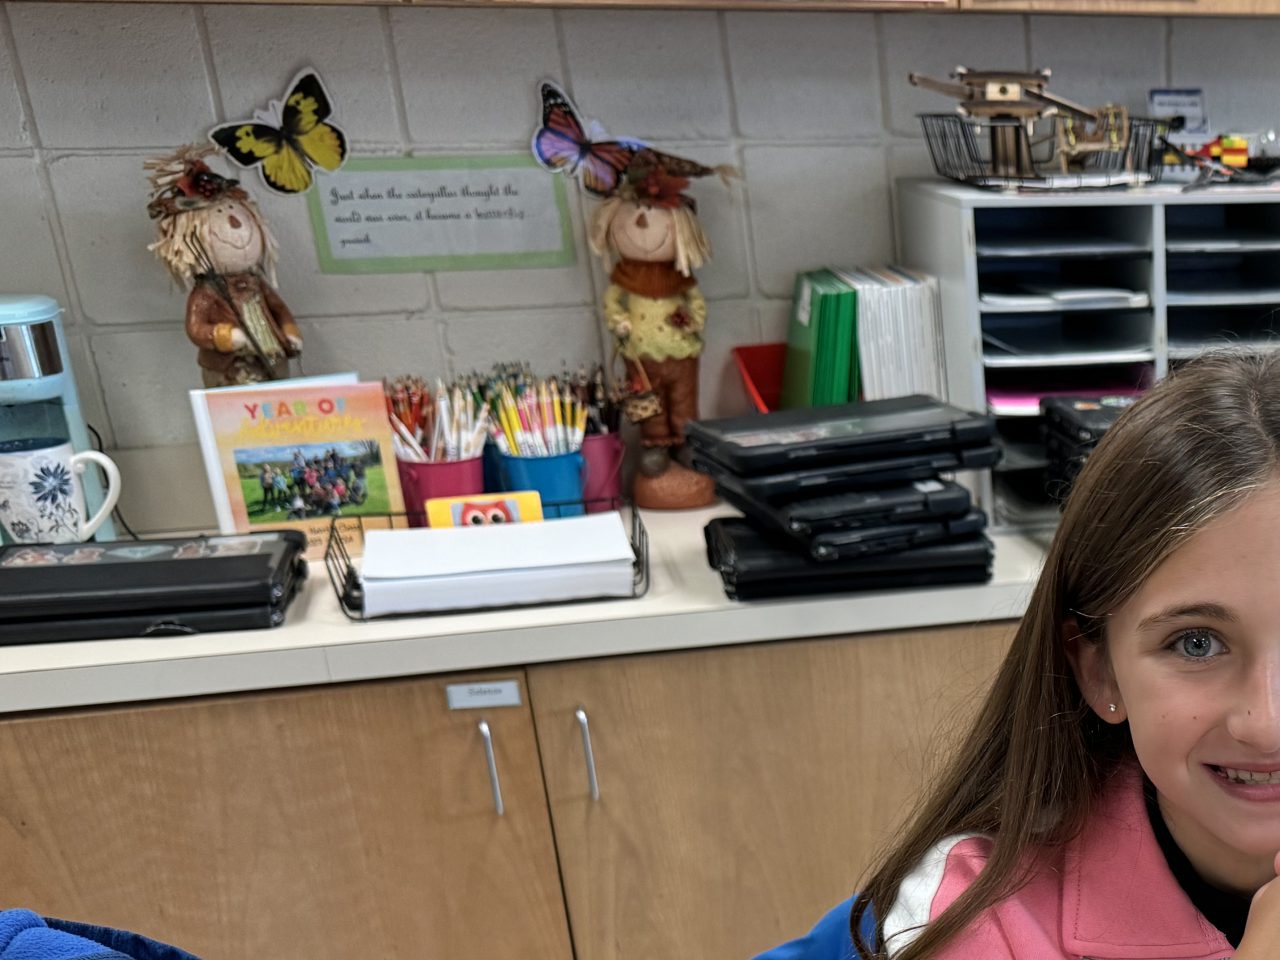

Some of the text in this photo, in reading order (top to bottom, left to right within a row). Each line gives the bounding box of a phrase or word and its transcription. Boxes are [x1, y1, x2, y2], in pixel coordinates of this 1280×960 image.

[386, 186, 402, 199] the
[461, 184, 499, 202] thought
[503, 184, 518, 196] the
[243, 397, 346, 420] YEAR OF
